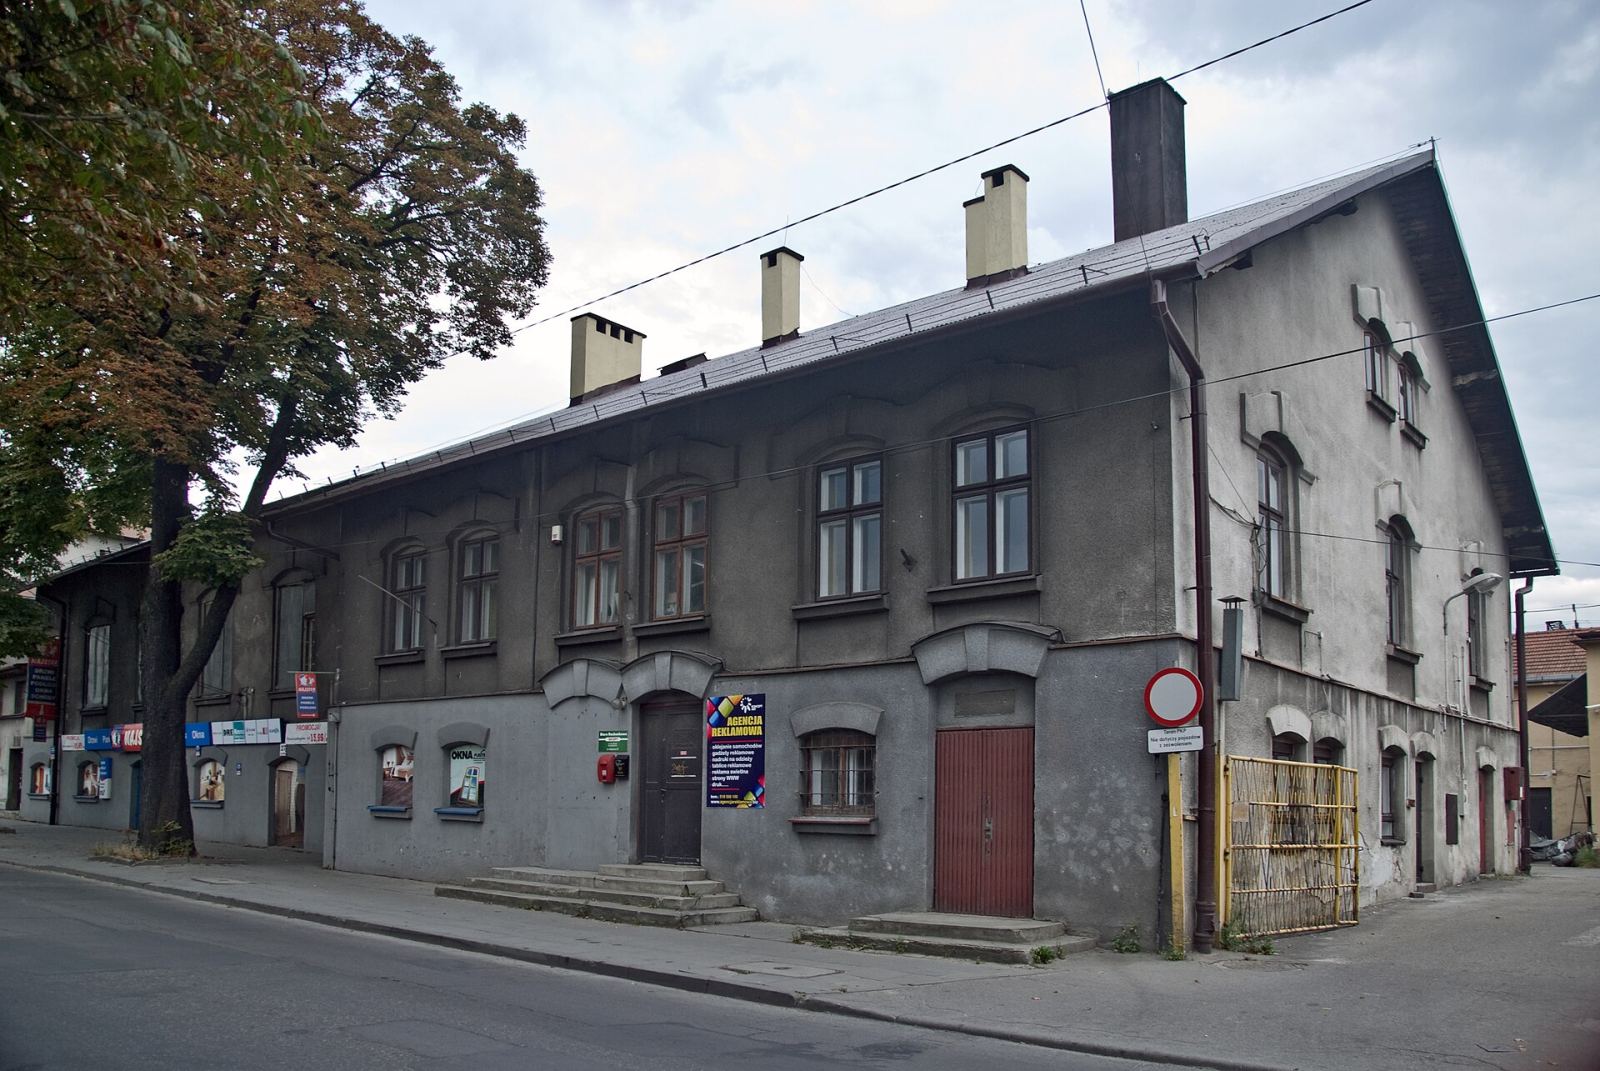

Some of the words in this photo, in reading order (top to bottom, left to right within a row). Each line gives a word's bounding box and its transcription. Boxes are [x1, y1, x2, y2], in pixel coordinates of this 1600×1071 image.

[727, 716, 762, 726] AGENCJA
[711, 726, 763, 737] REKLAMOWA
[124, 729, 143, 746] MAJS
[451, 750, 473, 759] OKNA
